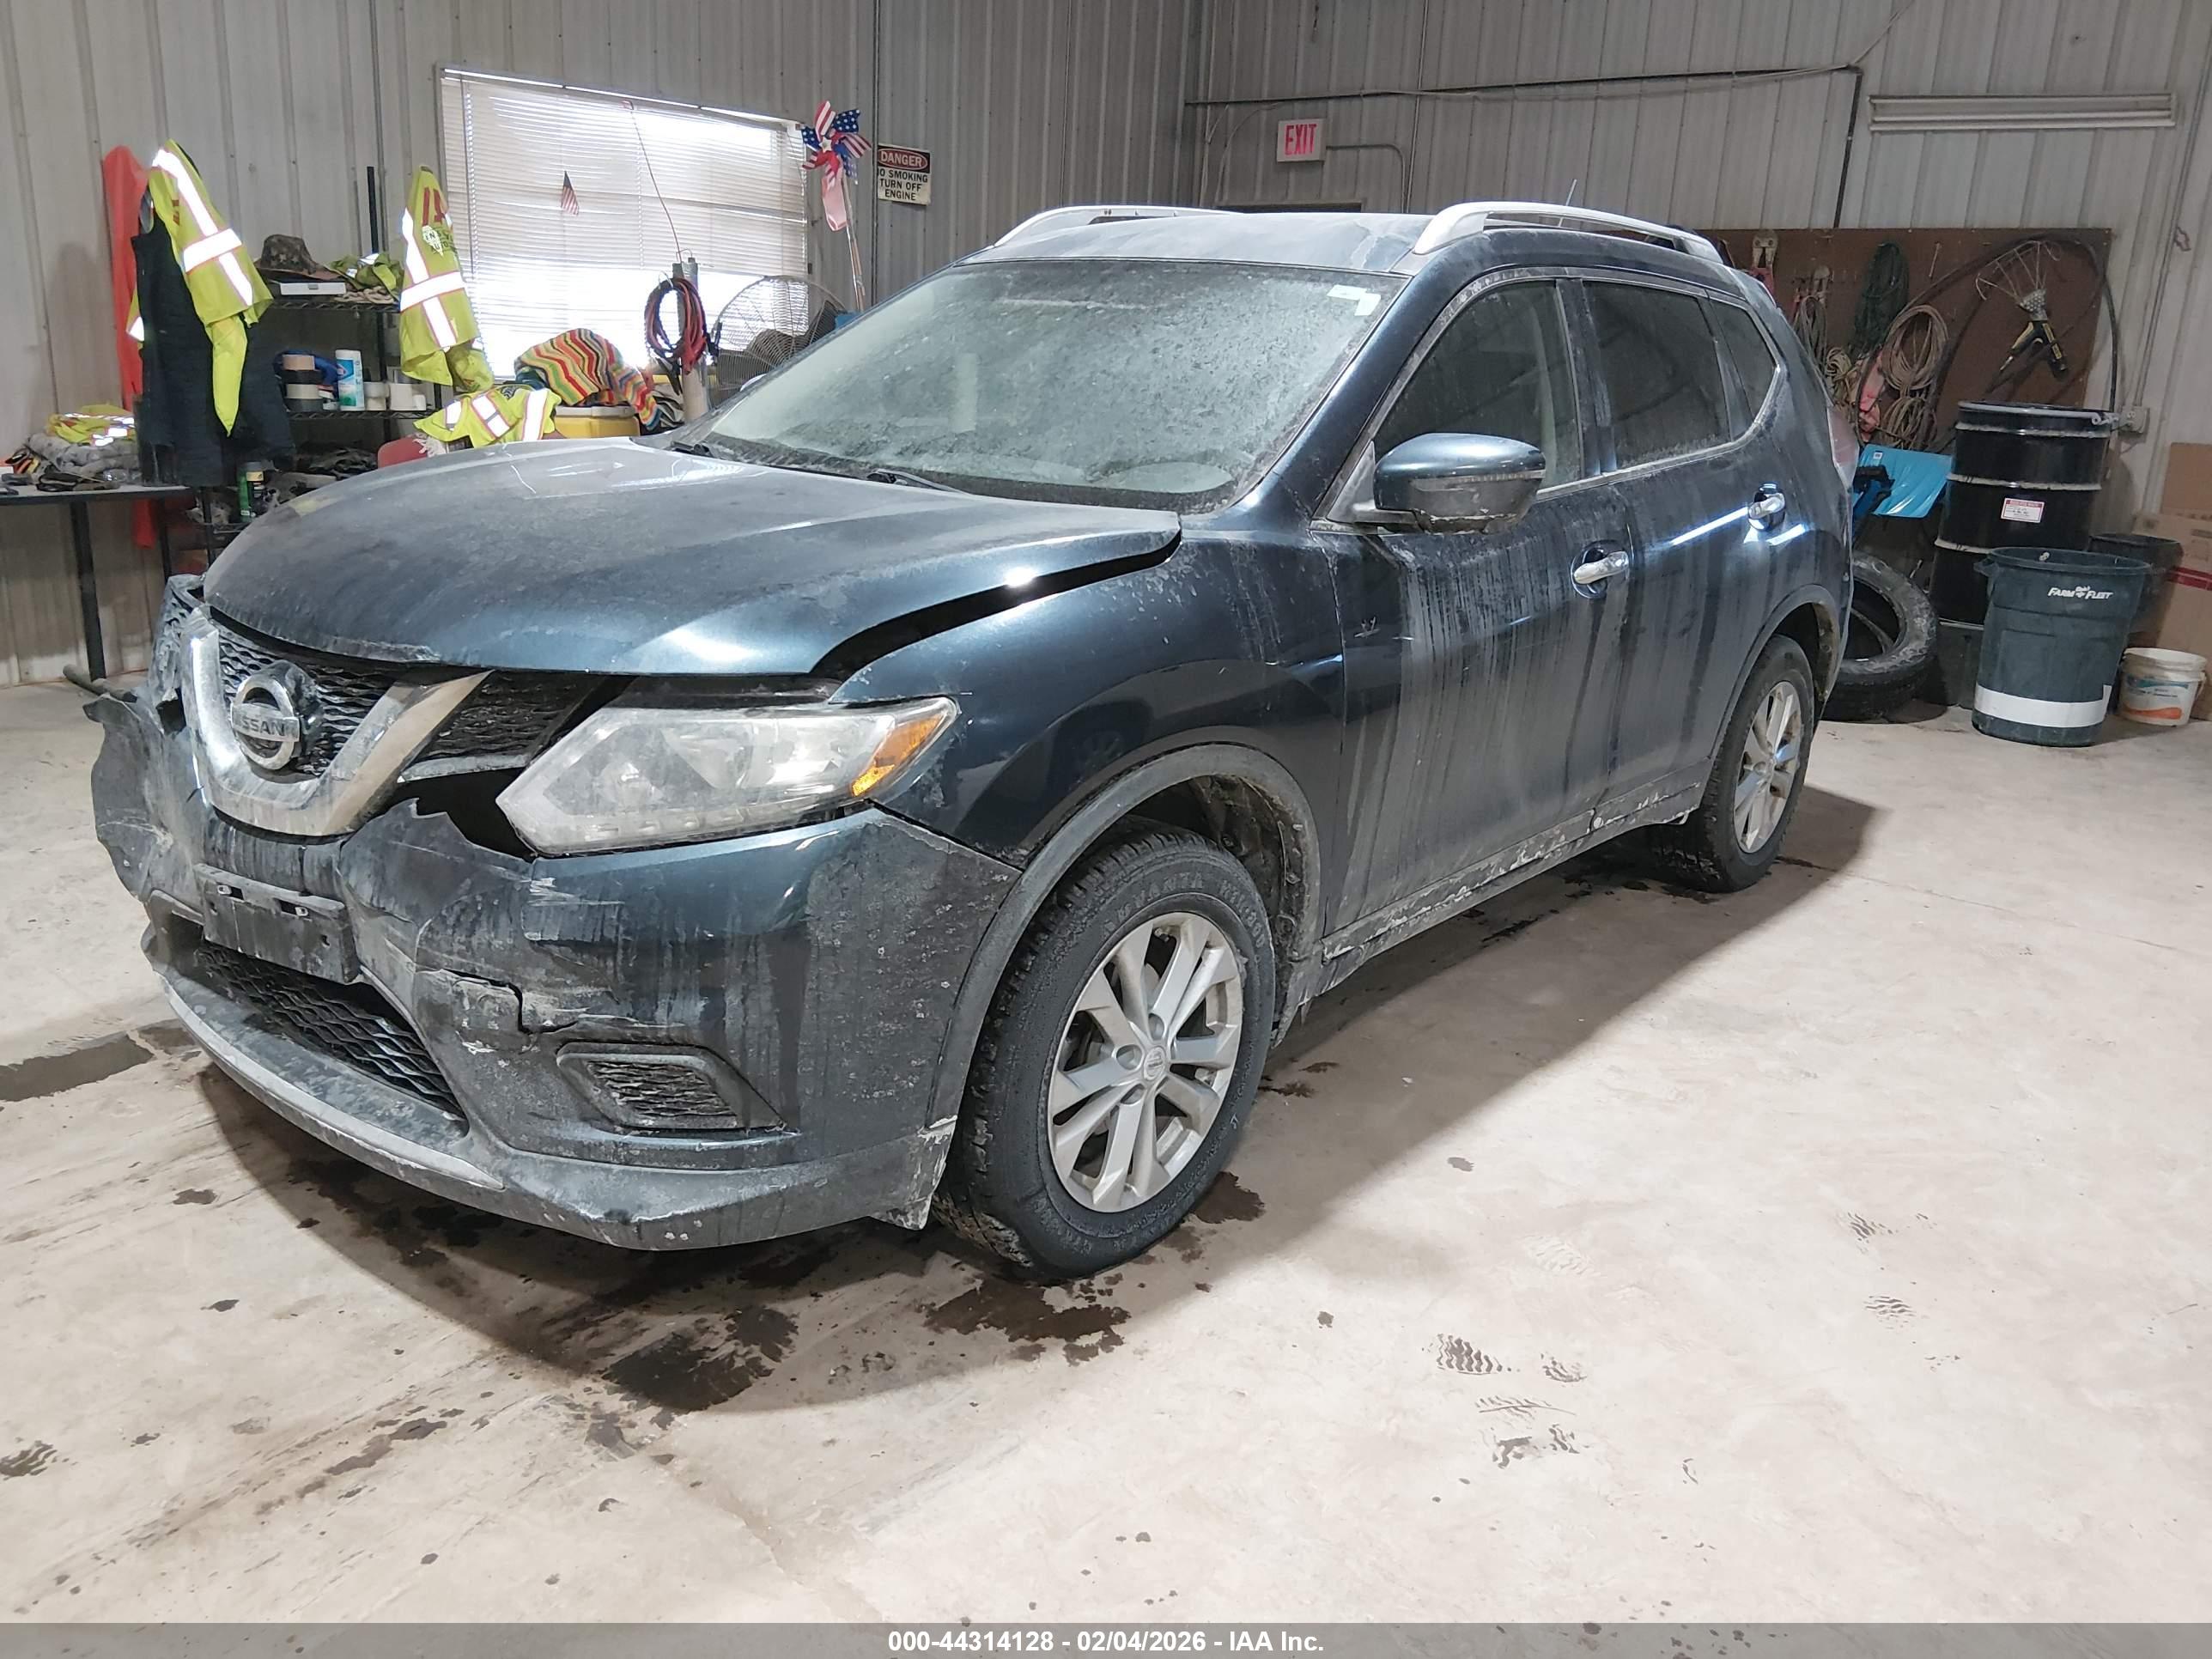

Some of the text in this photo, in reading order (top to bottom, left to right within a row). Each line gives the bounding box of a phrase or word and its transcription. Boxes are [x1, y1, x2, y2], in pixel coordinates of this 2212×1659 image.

[1285, 124, 1317, 155] EXIT
[880, 150, 922, 167] DANGER
[888, 169, 928, 183] SMOKING
[879, 178, 922, 192] TURN OFF
[884, 188, 917, 201] ENGINE
[2047, 586, 2075, 597] FARM
